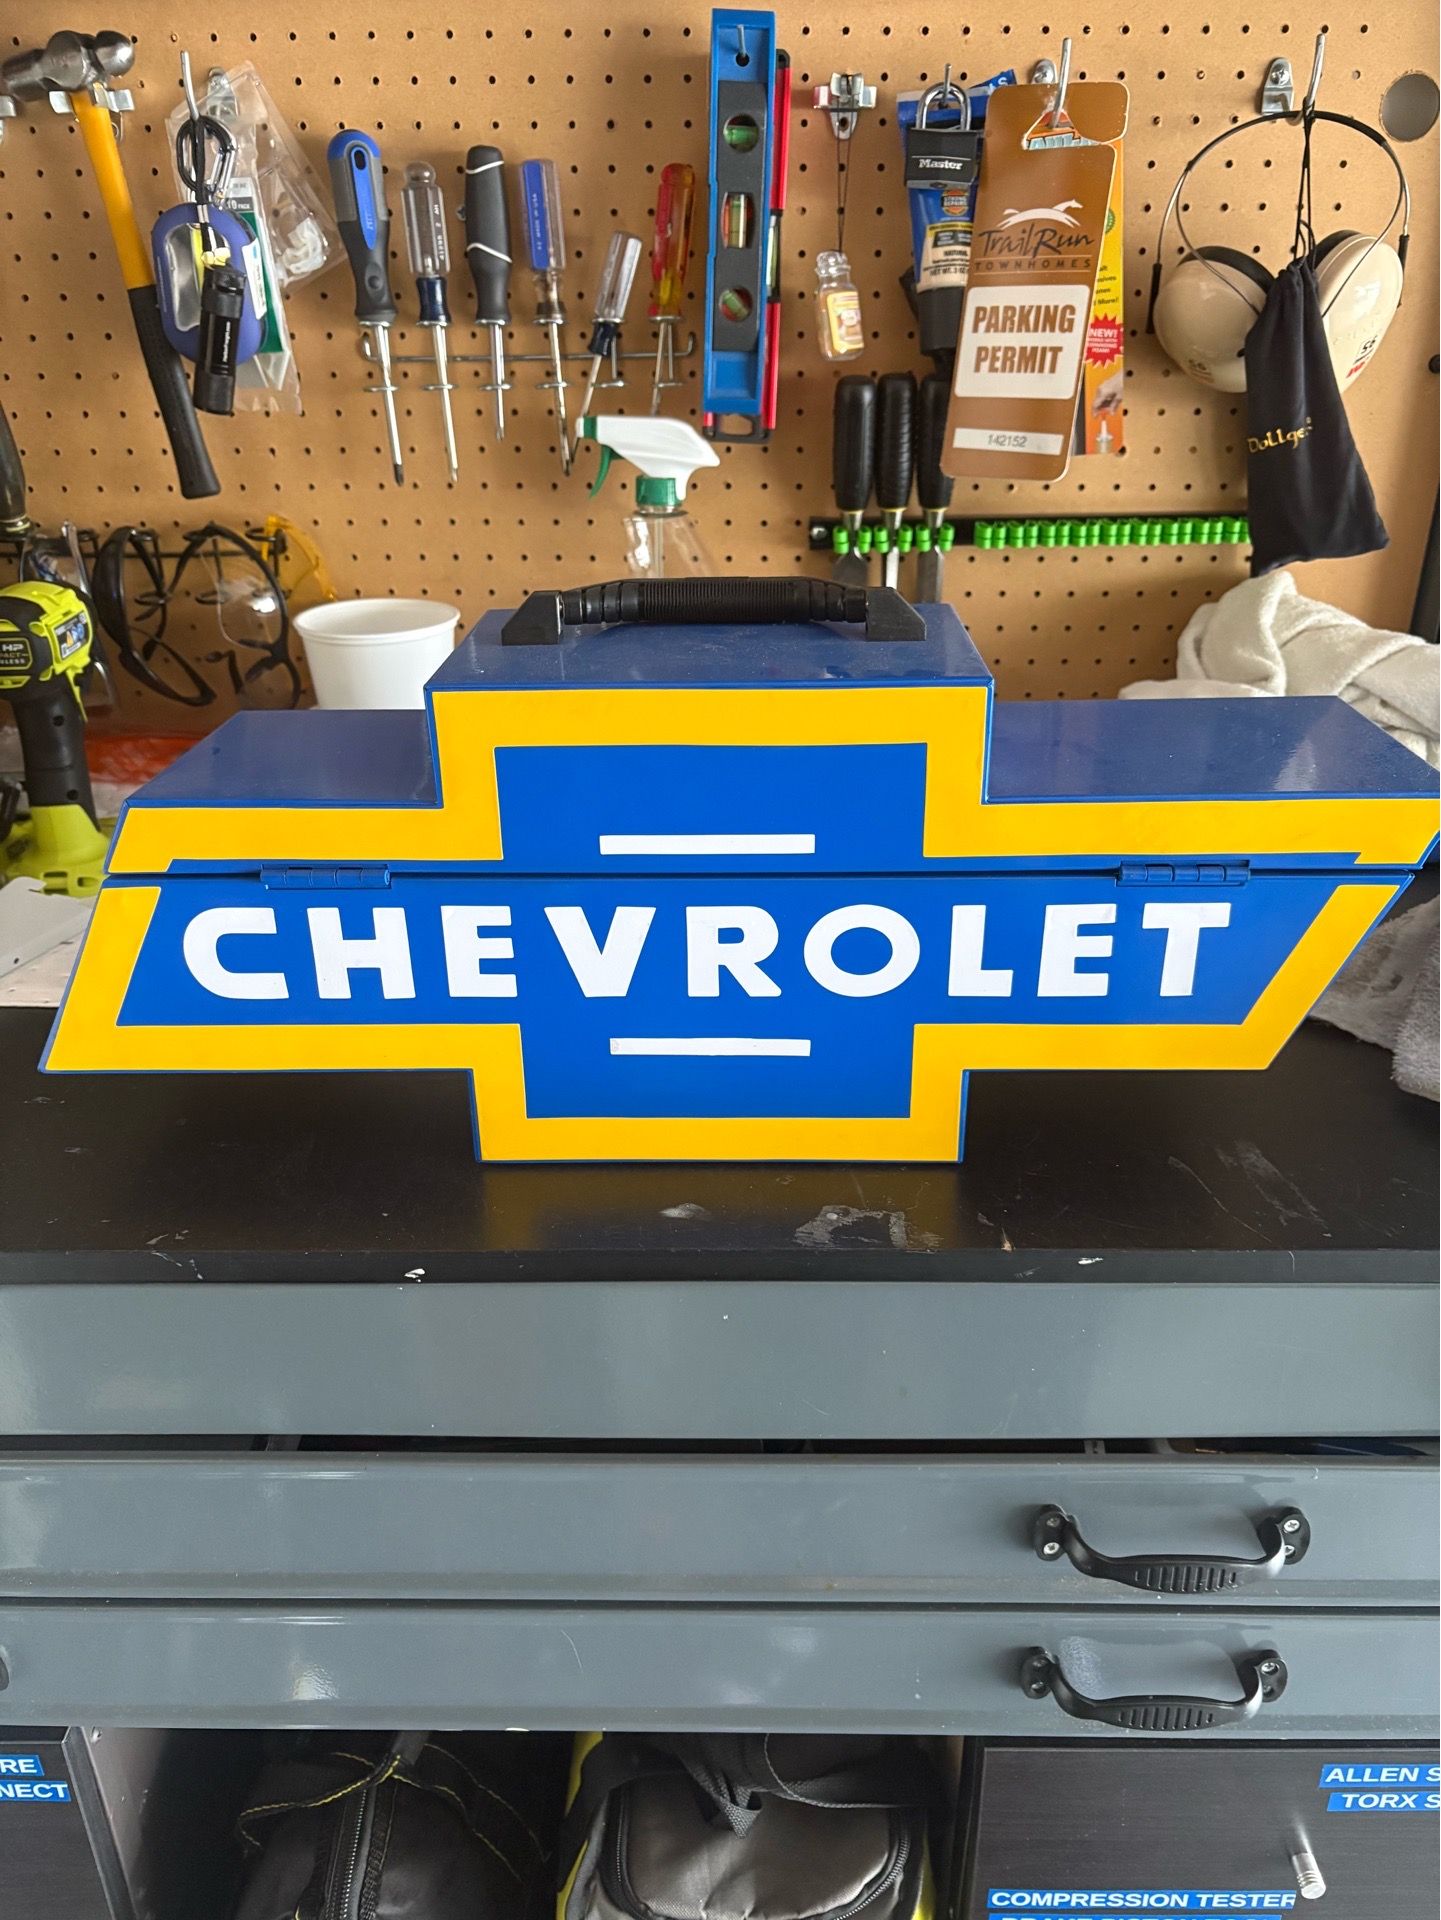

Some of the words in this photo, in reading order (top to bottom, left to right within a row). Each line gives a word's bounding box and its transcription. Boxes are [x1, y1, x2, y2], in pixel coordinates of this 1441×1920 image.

[919, 158, 963, 170] Master
[974, 258, 1092, 272] TOWNHOMES
[972, 304, 1077, 333] PARKING
[1088, 328, 1118, 338] NEW!
[974, 346, 1063, 374] PERMIT
[2, 643, 24, 652] HP
[183, 902, 1231, 999] CHEVROLET
[0, 1759, 37, 1774] RE
[1325, 1767, 1419, 1783] ALLEN
[1341, 1793, 1419, 1809] TORX
[991, 1892, 1189, 1908] COMPRESSION
[1196, 1892, 1296, 1908] TESTER
